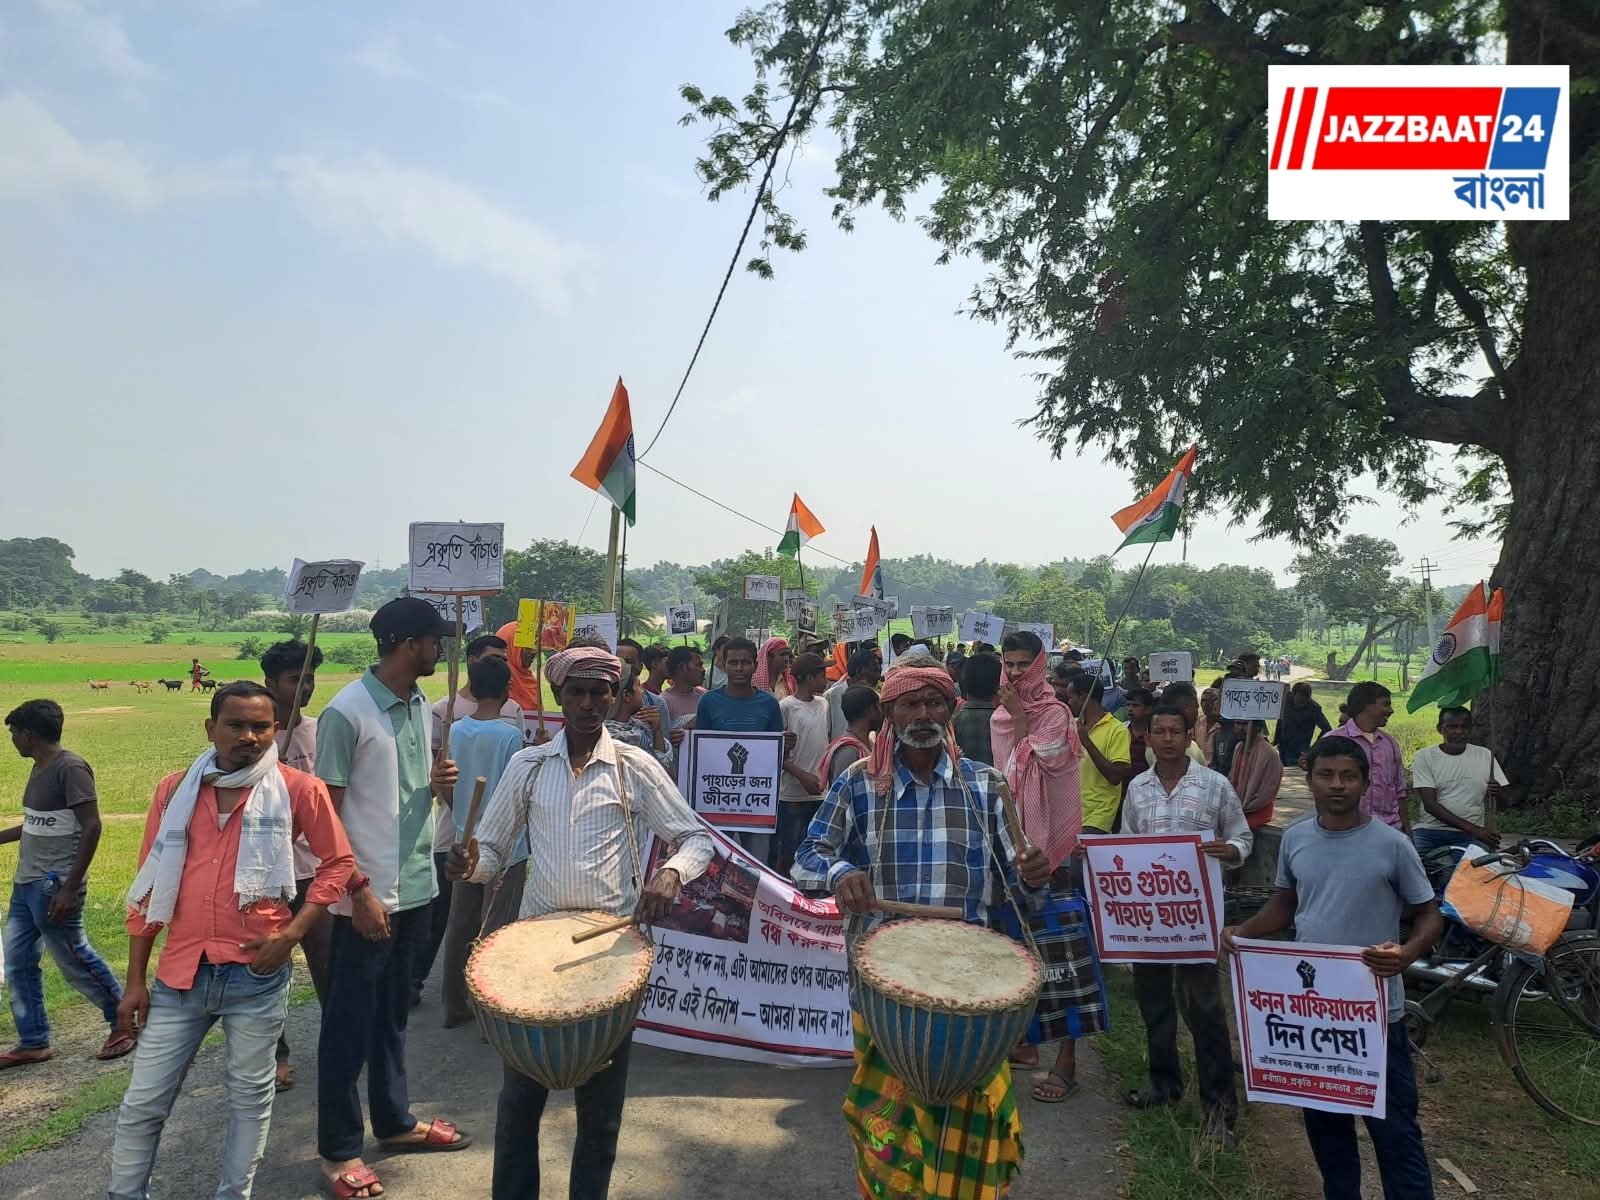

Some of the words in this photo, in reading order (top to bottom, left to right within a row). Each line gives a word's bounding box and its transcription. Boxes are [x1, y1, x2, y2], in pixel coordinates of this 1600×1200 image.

[702, 774, 746, 790] পাহাড়ের
[749, 775, 773, 789] জন্য
[703, 786, 742, 806] জীবন
[745, 792, 771, 807] দেব
[1096, 871, 1132, 898] হাত
[1137, 863, 1199, 897] গুটাও,
[815, 923, 846, 937] পাথ
[1104, 900, 1154, 932] পাহাড়
[1155, 899, 1205, 930] ছাড়ো
[677, 947, 693, 979] শুধু
[694, 949, 713, 976] শব্দ
[731, 950, 748, 982] এটা
[749, 958, 788, 985] আমাদের
[791, 963, 813, 988] ওপর
[679, 984, 702, 1020] এই
[703, 986, 739, 1025] বিনাশ
[759, 1002, 796, 1032] আমরা
[798, 1005, 828, 1035] মানব
[831, 1008, 850, 1038] না!
[1248, 990, 1286, 1015] খনন
[1287, 989, 1377, 1023] মাফিয়াদের
[1265, 1013, 1305, 1051] দিন
[1311, 1028, 1368, 1058] শেষ!
